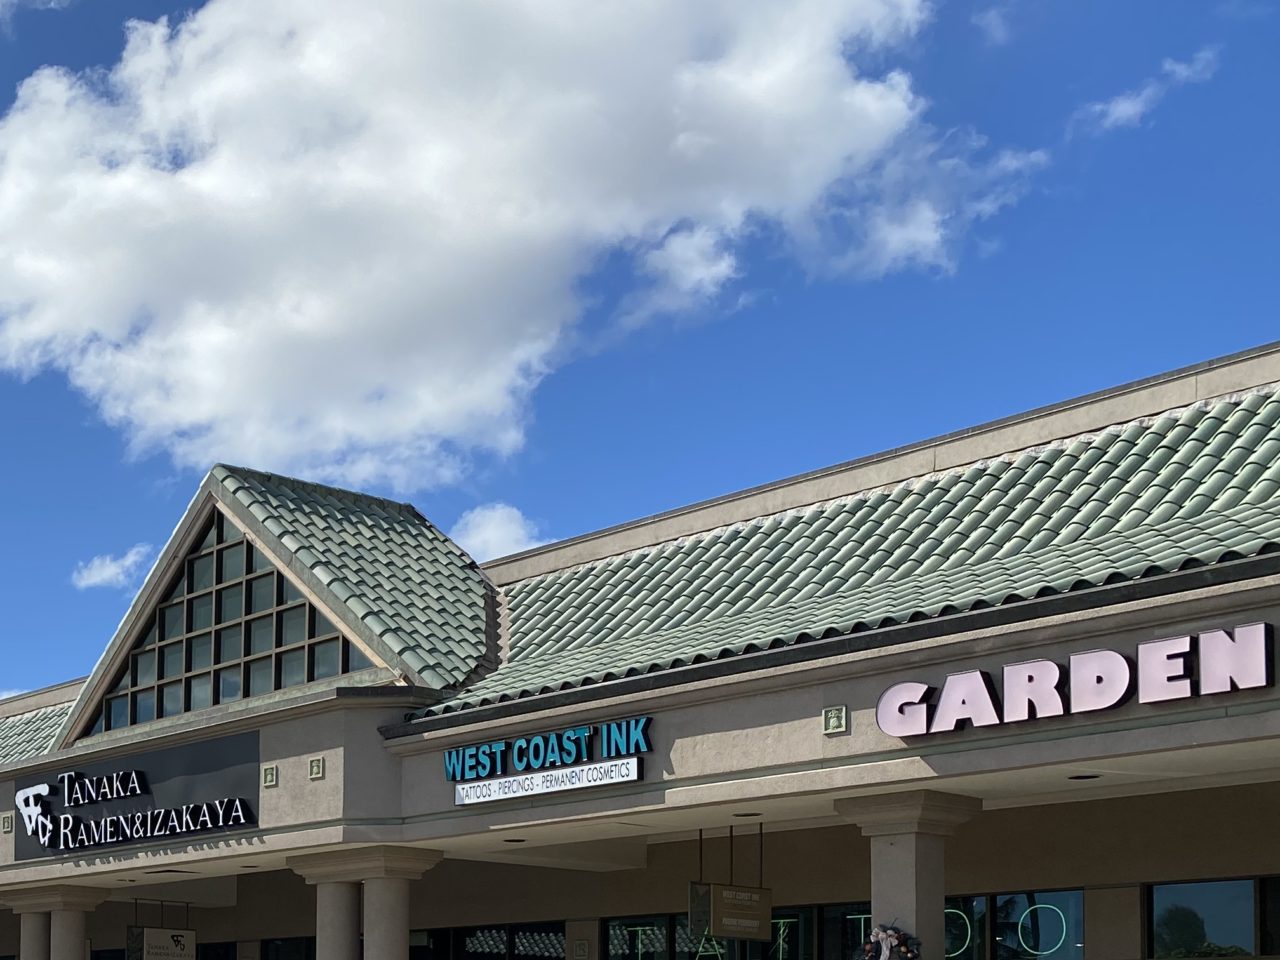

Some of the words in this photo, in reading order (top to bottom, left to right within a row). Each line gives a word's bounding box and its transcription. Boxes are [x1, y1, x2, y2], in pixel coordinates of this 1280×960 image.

[876, 622, 1267, 738] GARDEN
[443, 739, 506, 782] WEST
[512, 727, 590, 772] COAST
[601, 717, 648, 759] INK
[58, 769, 143, 808] TANAKA
[461, 784, 492, 801] TATTOOS
[498, 777, 535, 796] PIERCINGS
[541, 769, 585, 790] PERMANENT
[586, 762, 630, 783] COSMETICS
